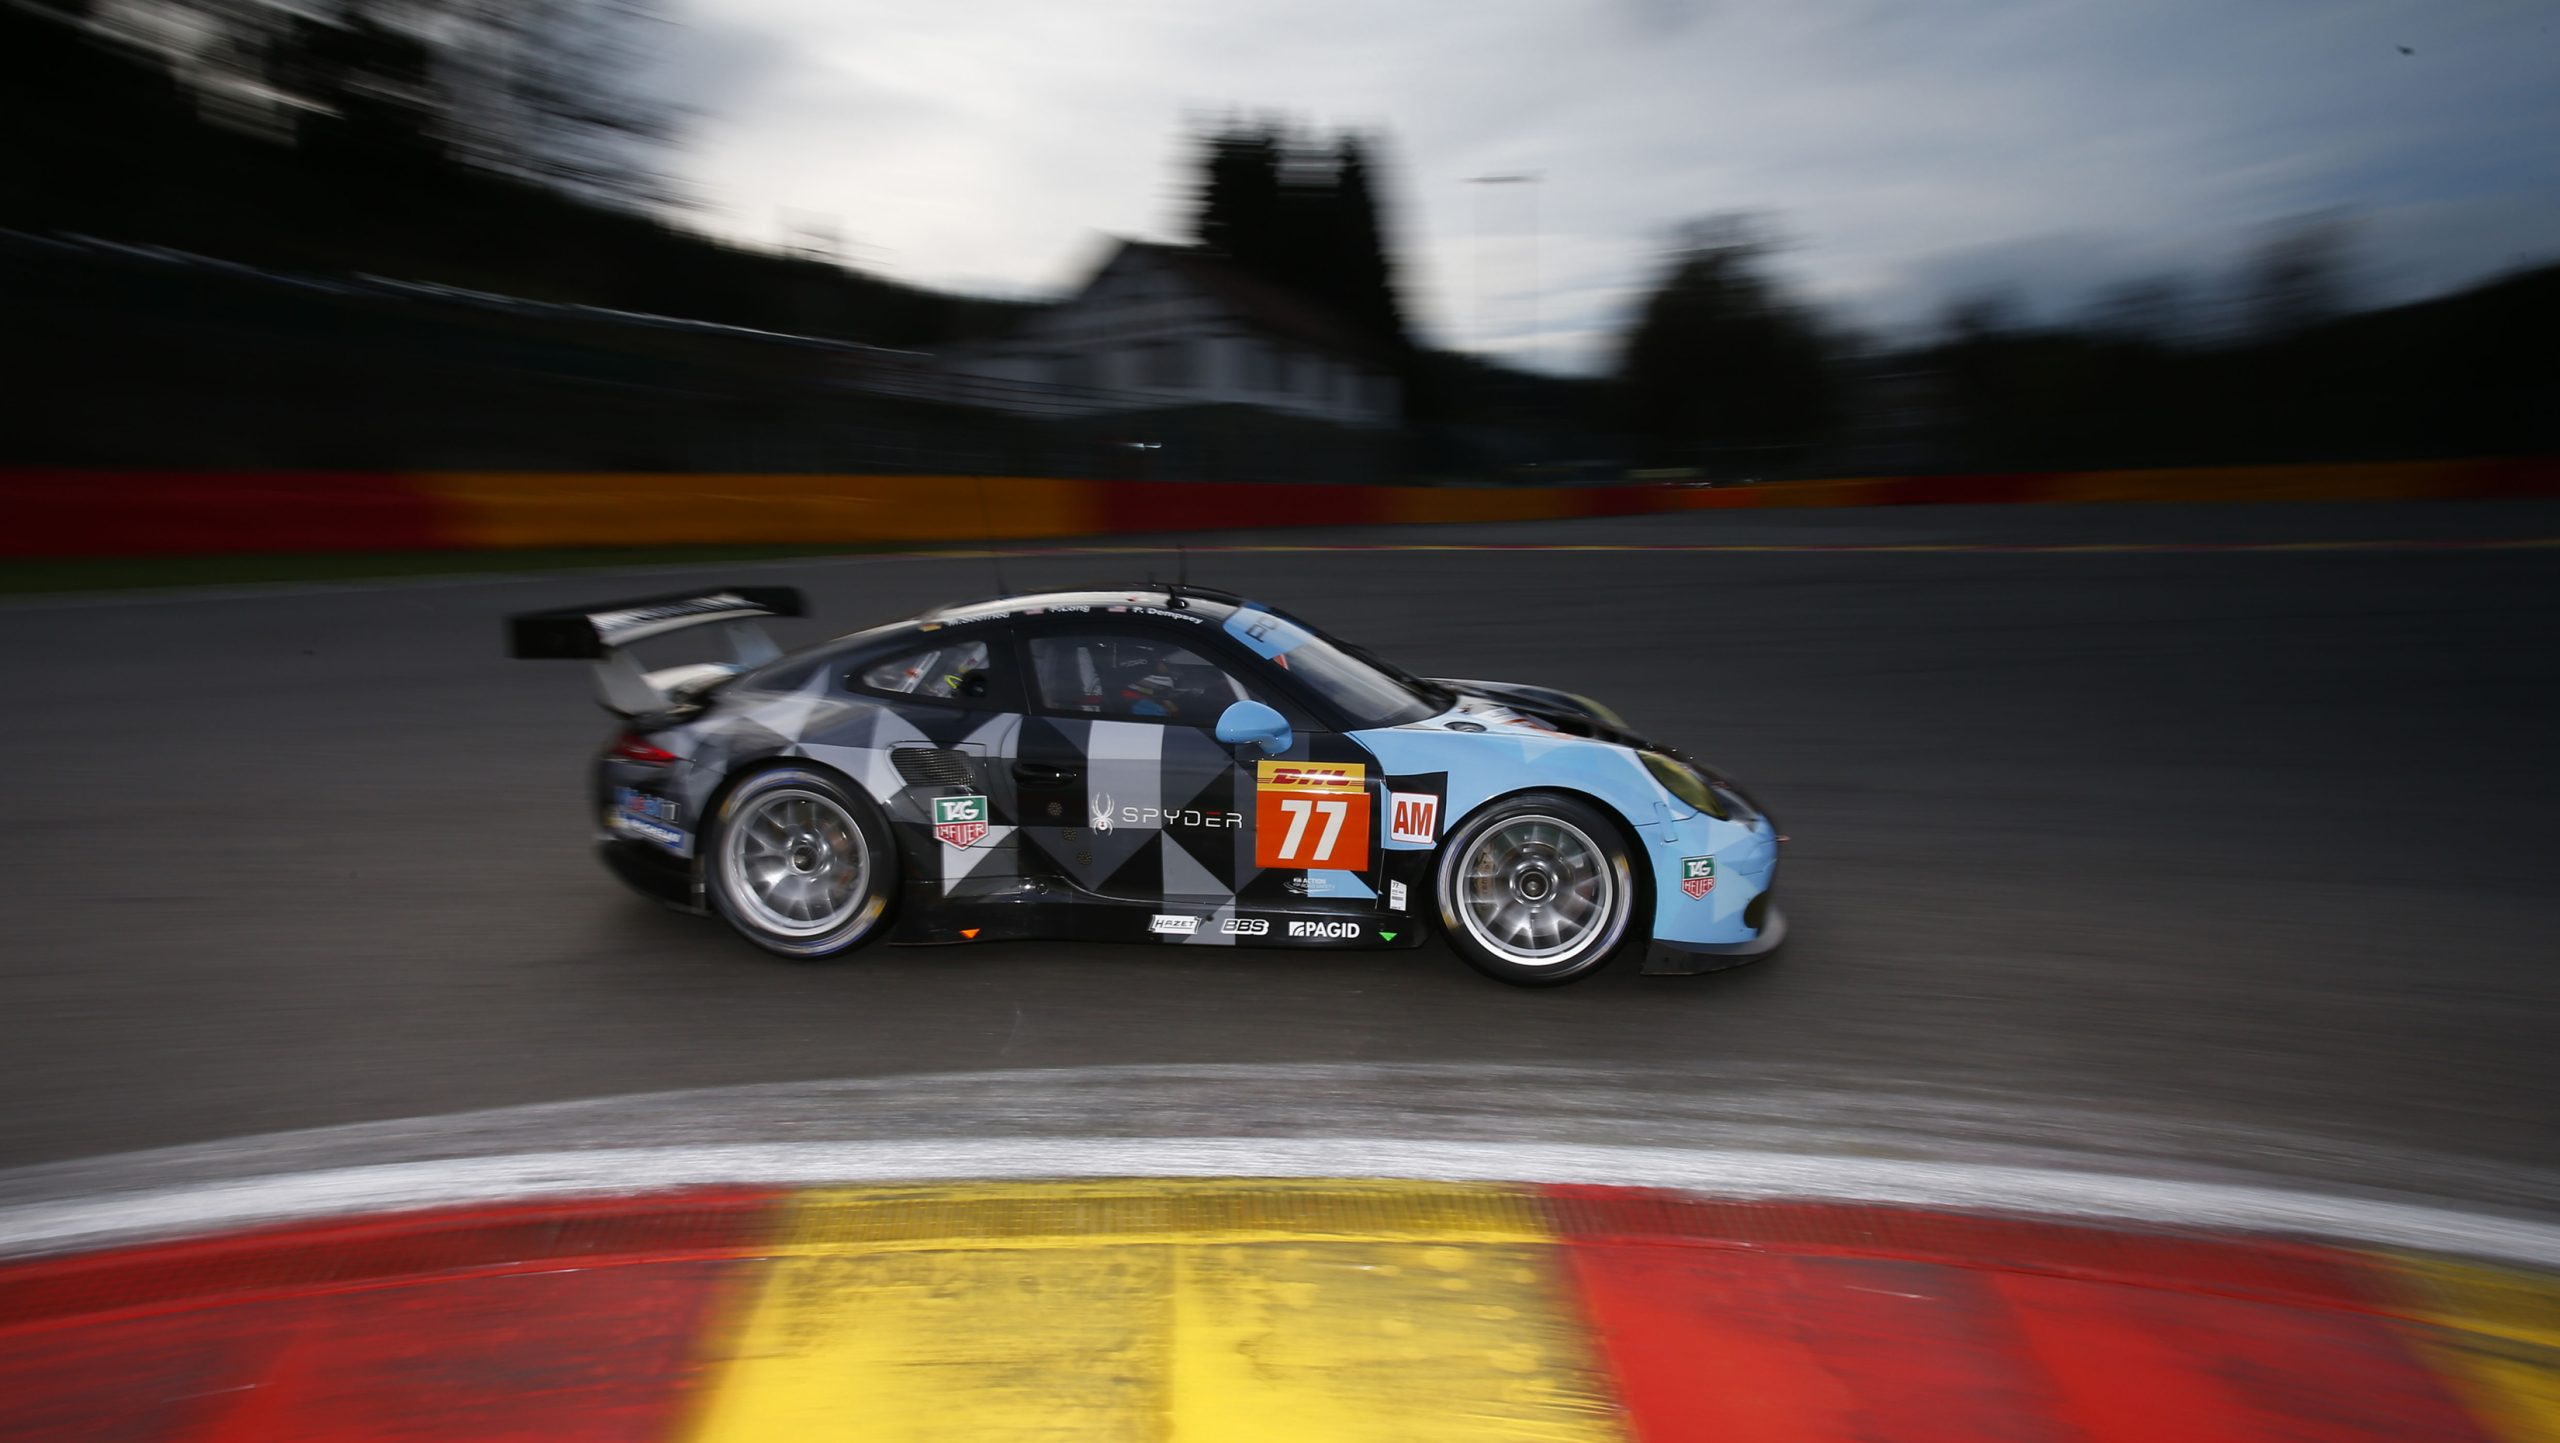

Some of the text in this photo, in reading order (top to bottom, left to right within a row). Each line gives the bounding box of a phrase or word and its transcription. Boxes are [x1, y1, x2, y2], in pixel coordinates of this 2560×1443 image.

[1146, 606, 1204, 625] Dempsey
[1272, 768, 1351, 786] DHL
[940, 800, 979, 820] TAG
[1122, 806, 1243, 829] SPYDER
[1393, 801, 1433, 837] AM
[940, 824, 985, 845] HEUER
[1277, 799, 1348, 861] 77
[1687, 860, 1711, 877] TAG
[1684, 879, 1713, 896] HEUER
[1155, 919, 1194, 929] HAZET
[1222, 919, 1268, 935] BBS
[1305, 921, 1360, 939] PAGID
